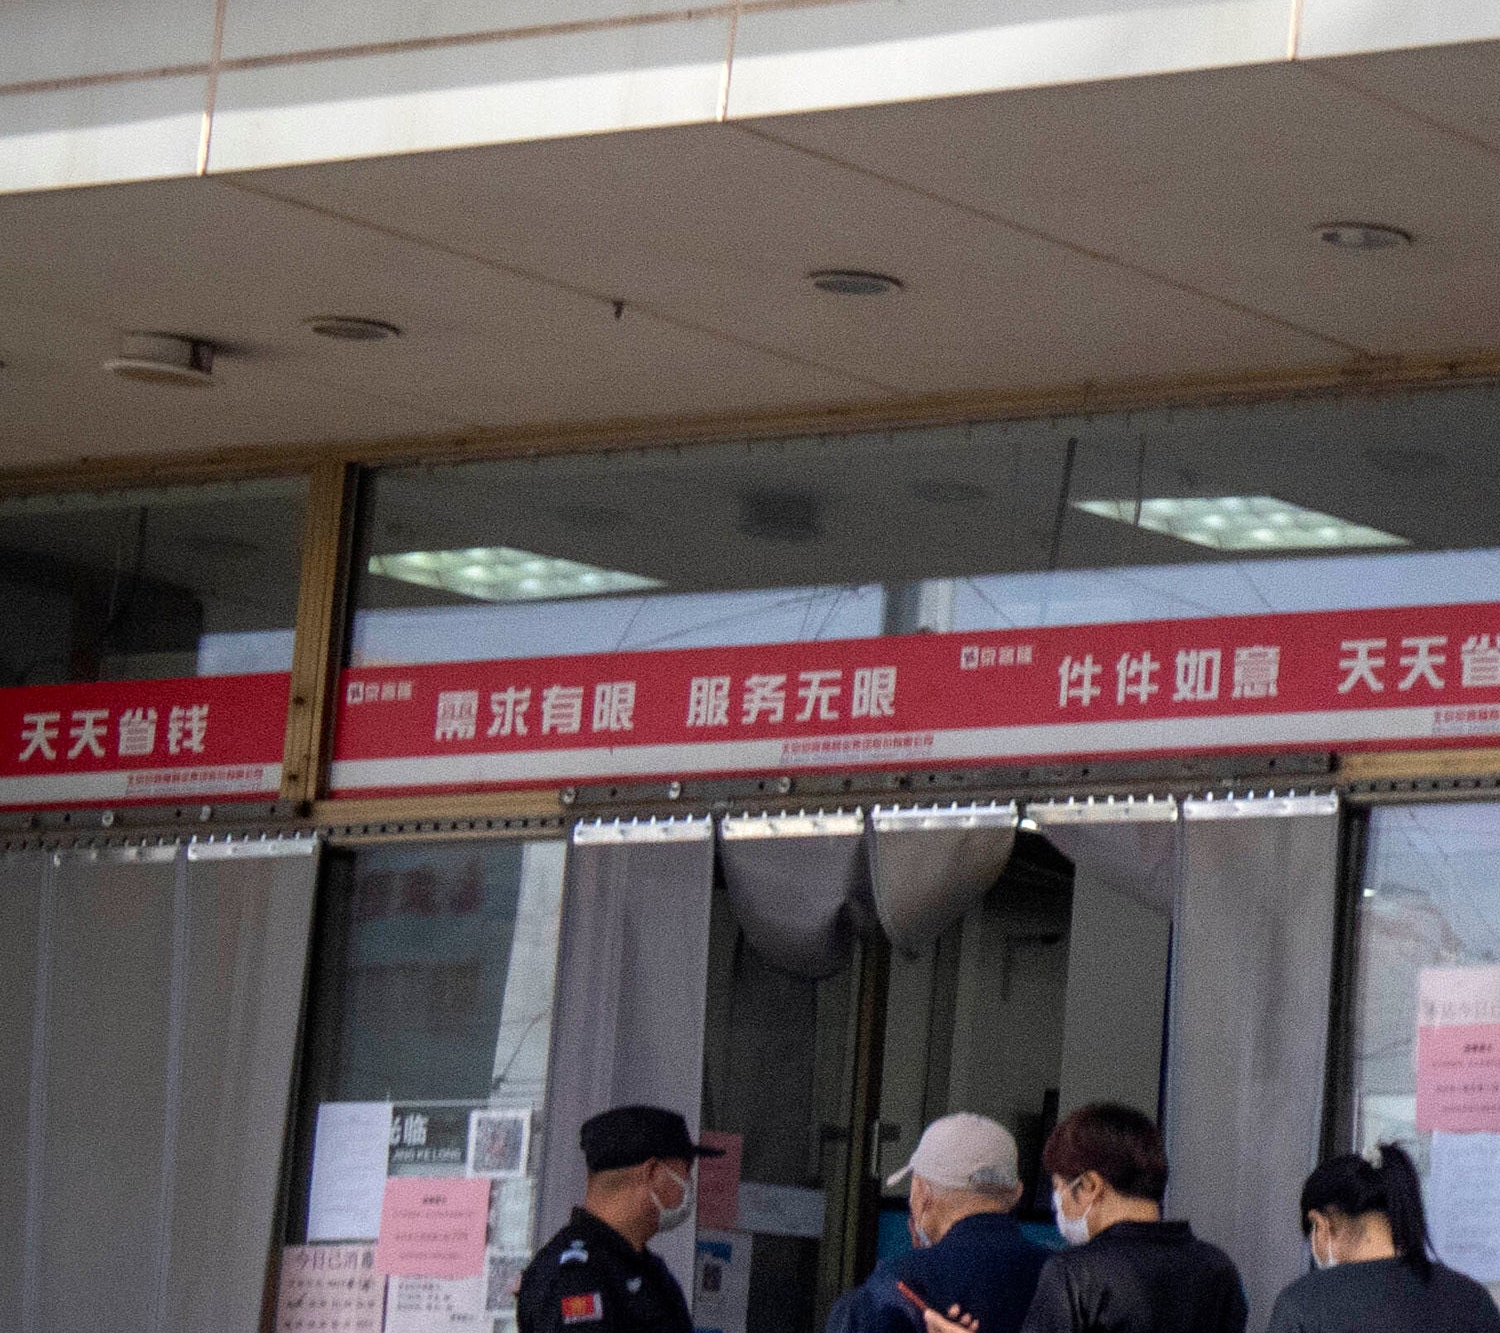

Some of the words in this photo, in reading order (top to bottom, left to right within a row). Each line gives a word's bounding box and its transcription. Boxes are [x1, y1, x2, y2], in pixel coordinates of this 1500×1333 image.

[434, 680, 637, 744] 需求有限
[685, 665, 898, 729] 服务无限
[1056, 643, 1282, 710] 件件如意
[17, 702, 211, 763] 天天省钱
